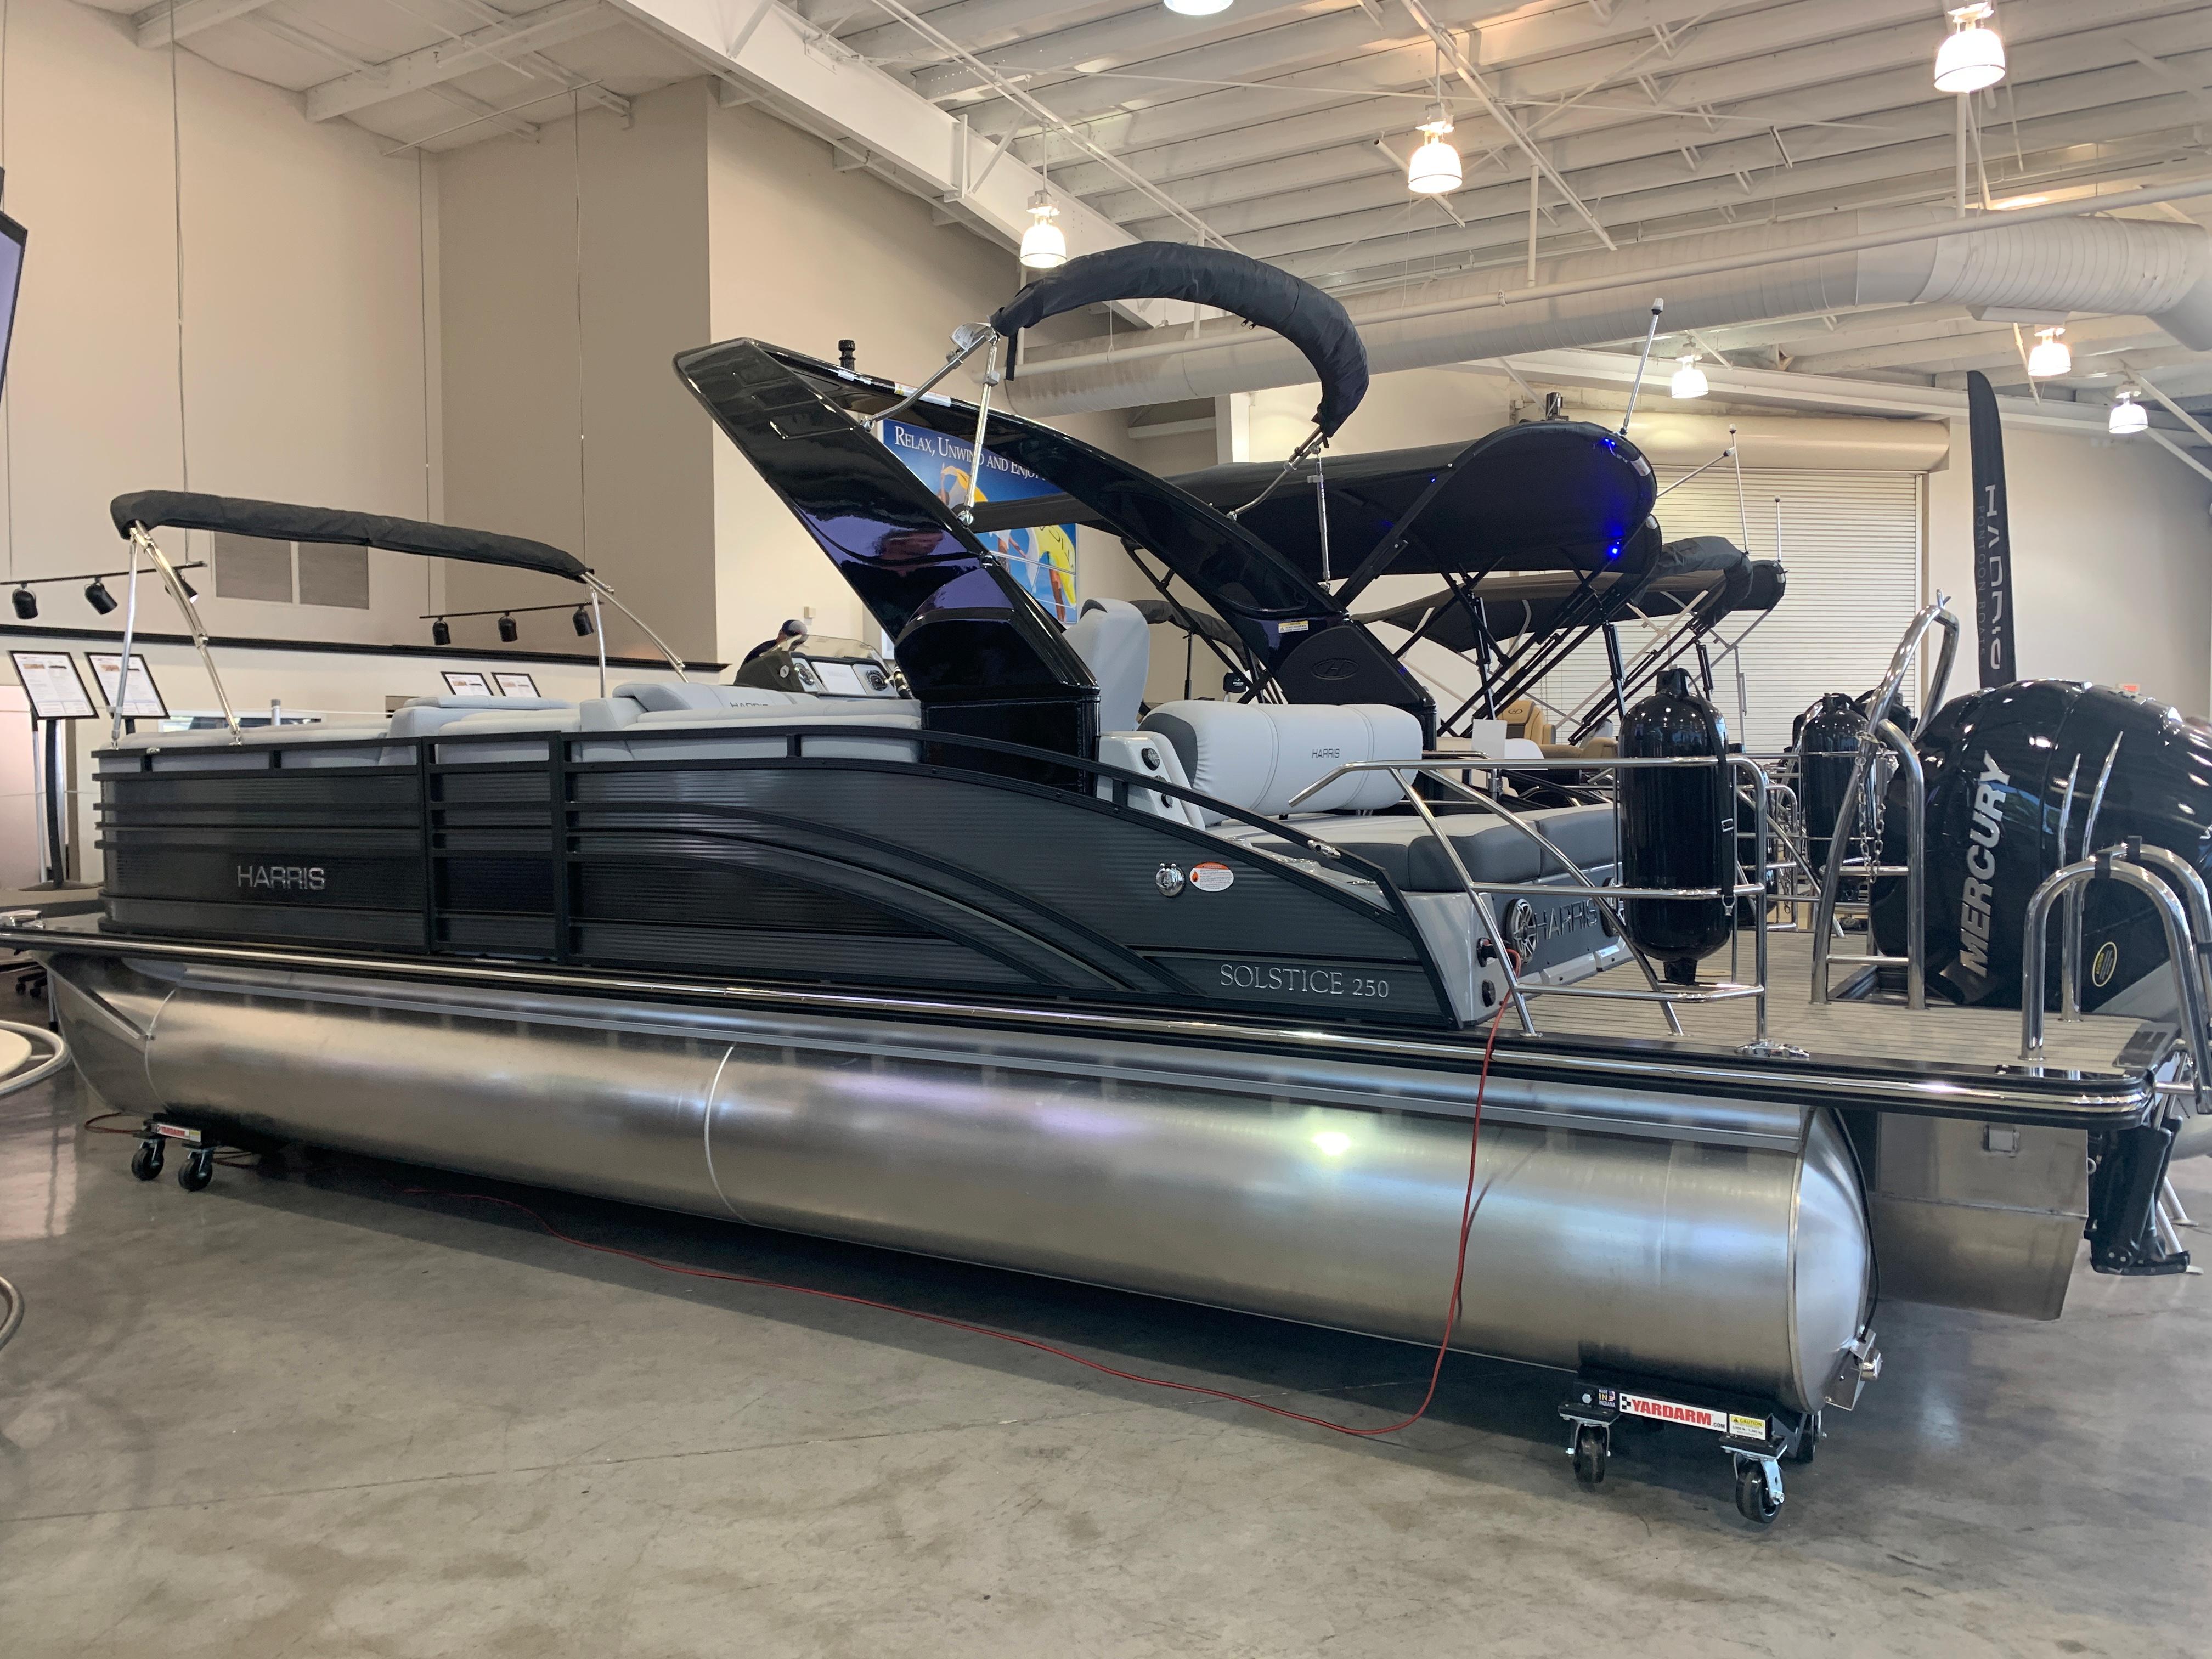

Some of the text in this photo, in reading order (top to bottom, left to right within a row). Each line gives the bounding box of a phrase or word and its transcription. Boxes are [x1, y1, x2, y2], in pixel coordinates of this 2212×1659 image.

[894, 426, 935, 456] RELAX,
[986, 455, 1009, 472] AND
[1976, 505, 1987, 591] PONTOON
[1312, 748, 1340, 759] HARRIS
[237, 865, 325, 890] HARRIS
[1960, 750, 2010, 978] MERCURY
[1534, 898, 1598, 943] HARRIS
[1221, 964, 1389, 998] SOLSTICE 250
[1599, 1393, 1608, 1401] IN
[1632, 1398, 1712, 1426] YARDARM
[1740, 1418, 1762, 1426] CAUTION
